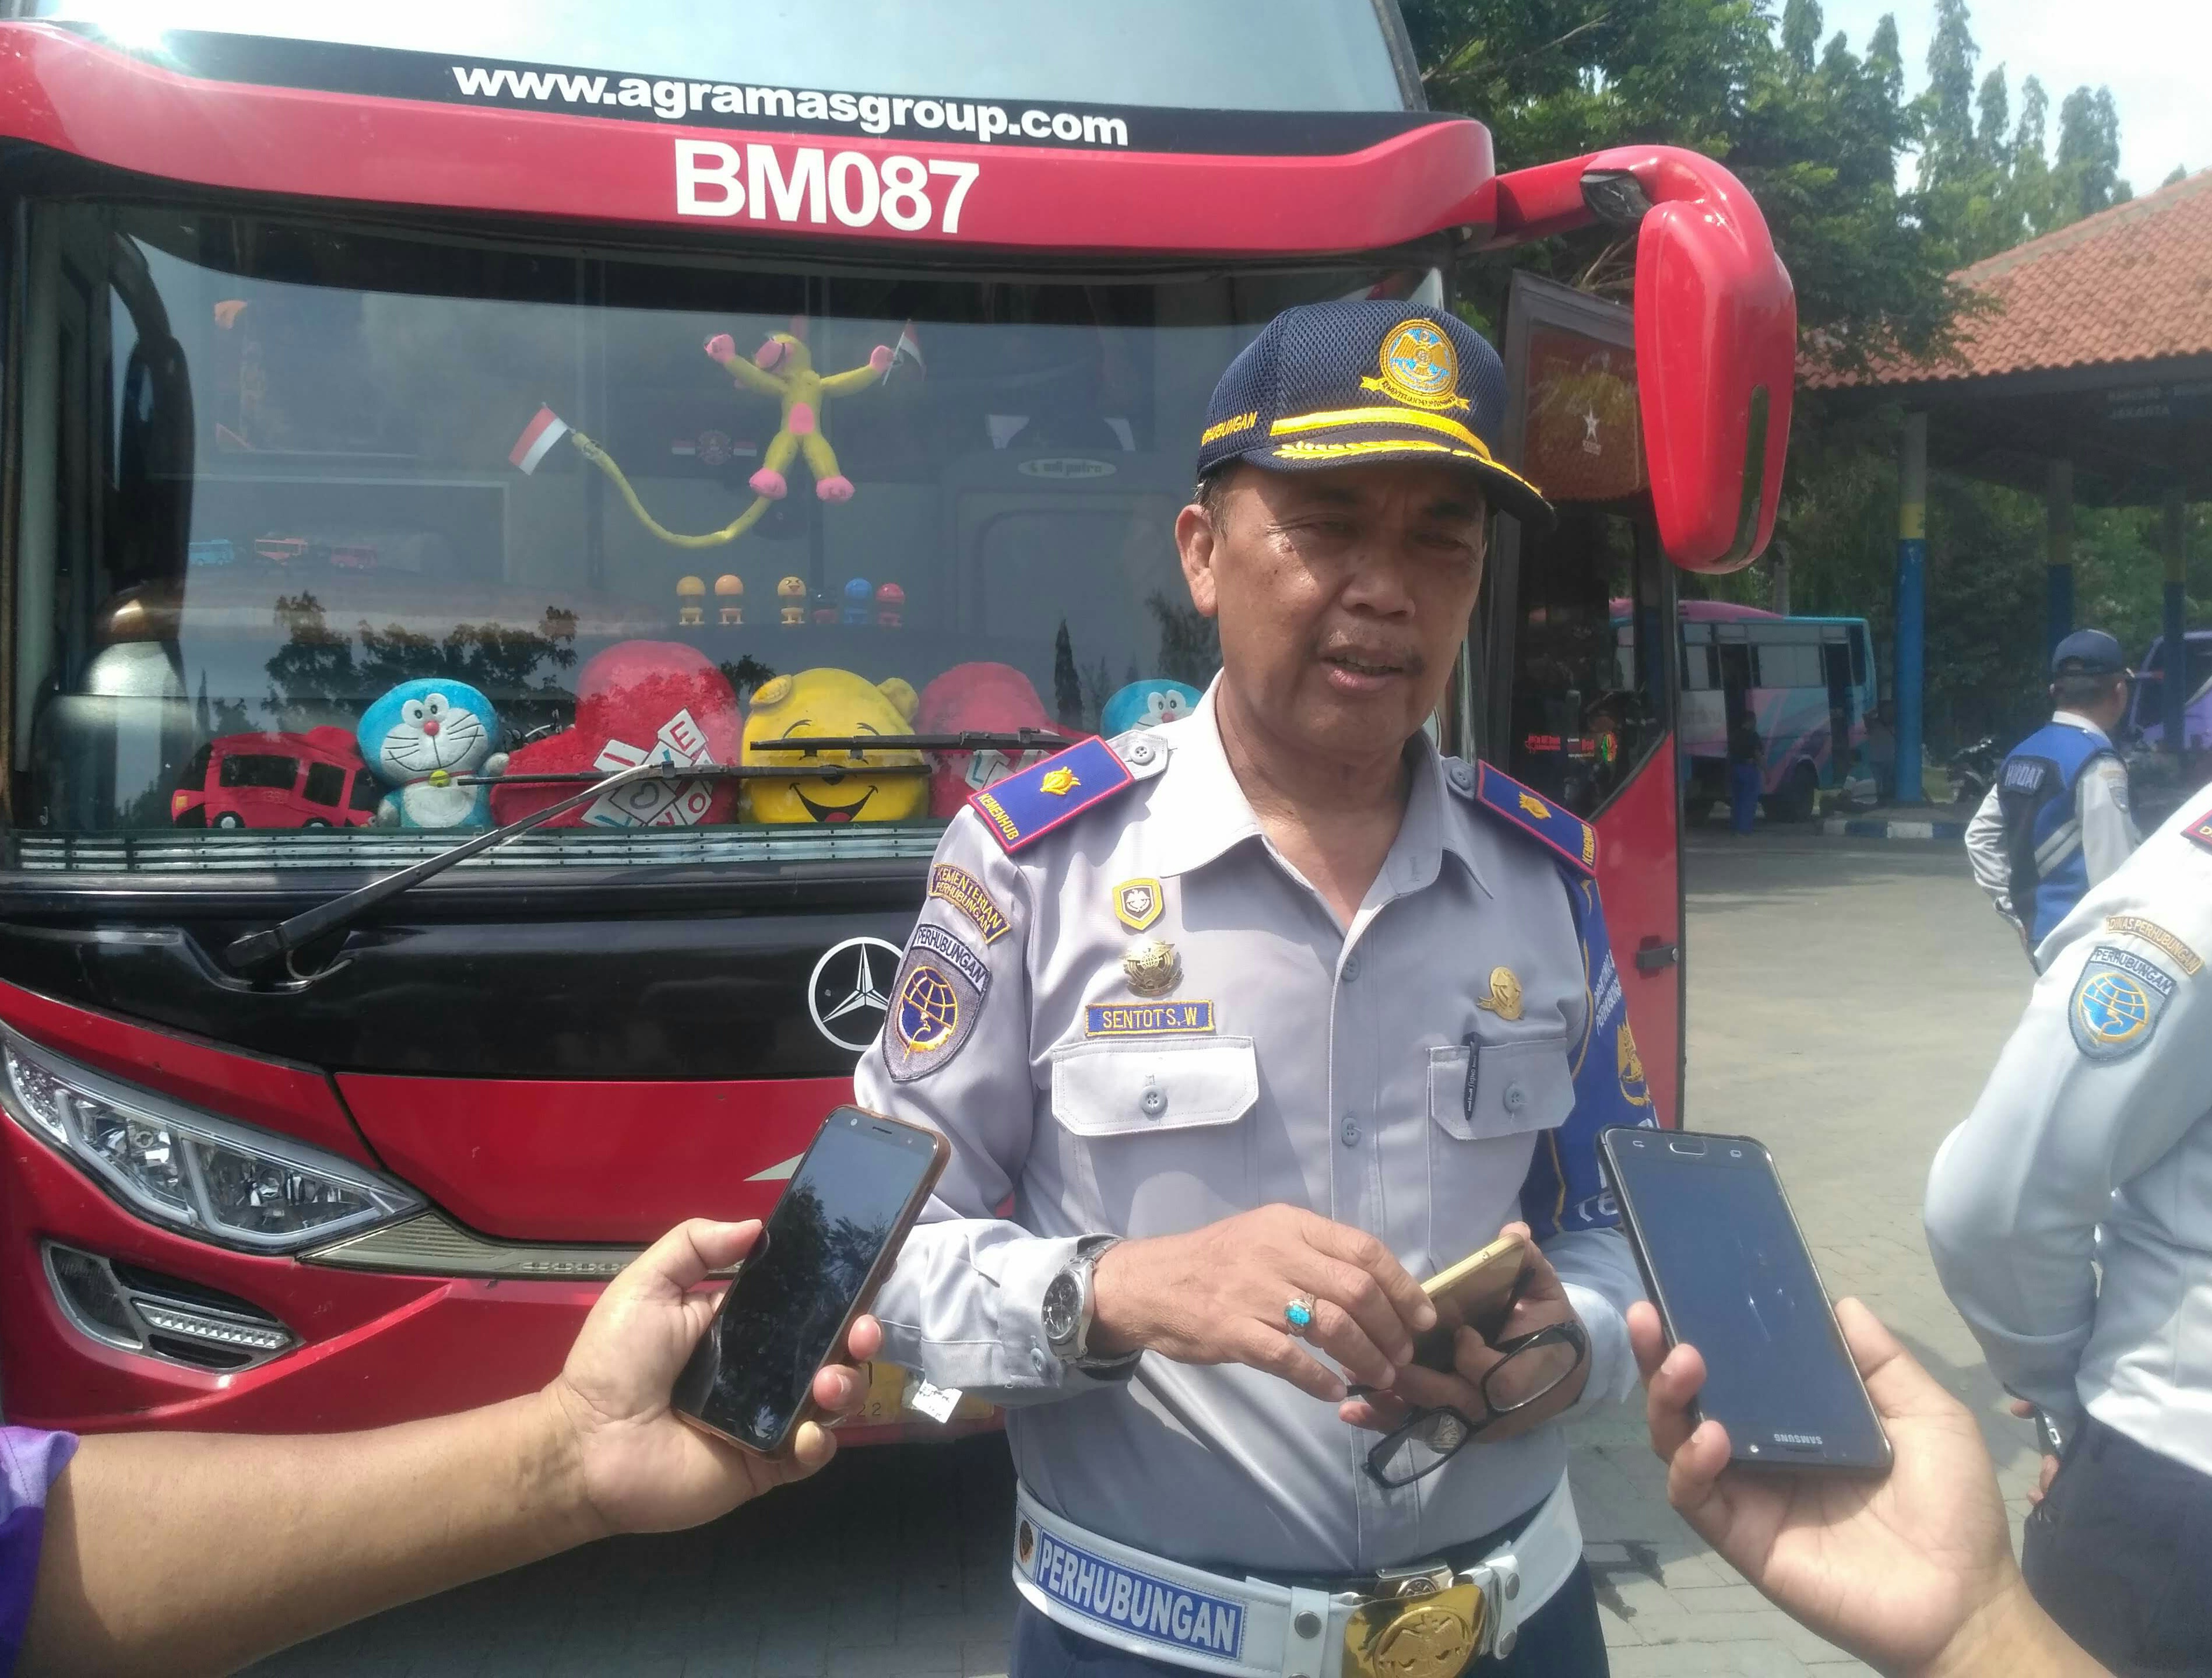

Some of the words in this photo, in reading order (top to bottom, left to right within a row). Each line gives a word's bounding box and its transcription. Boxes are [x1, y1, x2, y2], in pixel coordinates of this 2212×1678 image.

[452, 66, 1128, 145] www.agramasgroup.com
[674, 139, 980, 234] BM087
[977, 792, 1019, 840] KEMENHUB
[935, 882, 991, 933] PERHUBUNGAN
[936, 867, 1003, 929] KEMENTERIAN
[917, 928, 986, 983] PERHUBUNGAN
[2094, 949, 2172, 991] PERHUBUNGAN
[2133, 919, 2199, 971] PERHUBUNGAN
[1102, 1009, 1164, 1029] SENTOT
[1774, 1433, 1823, 1445] SAMSUNG
[1039, 1539, 1236, 1652] PERHUBUNGAN
